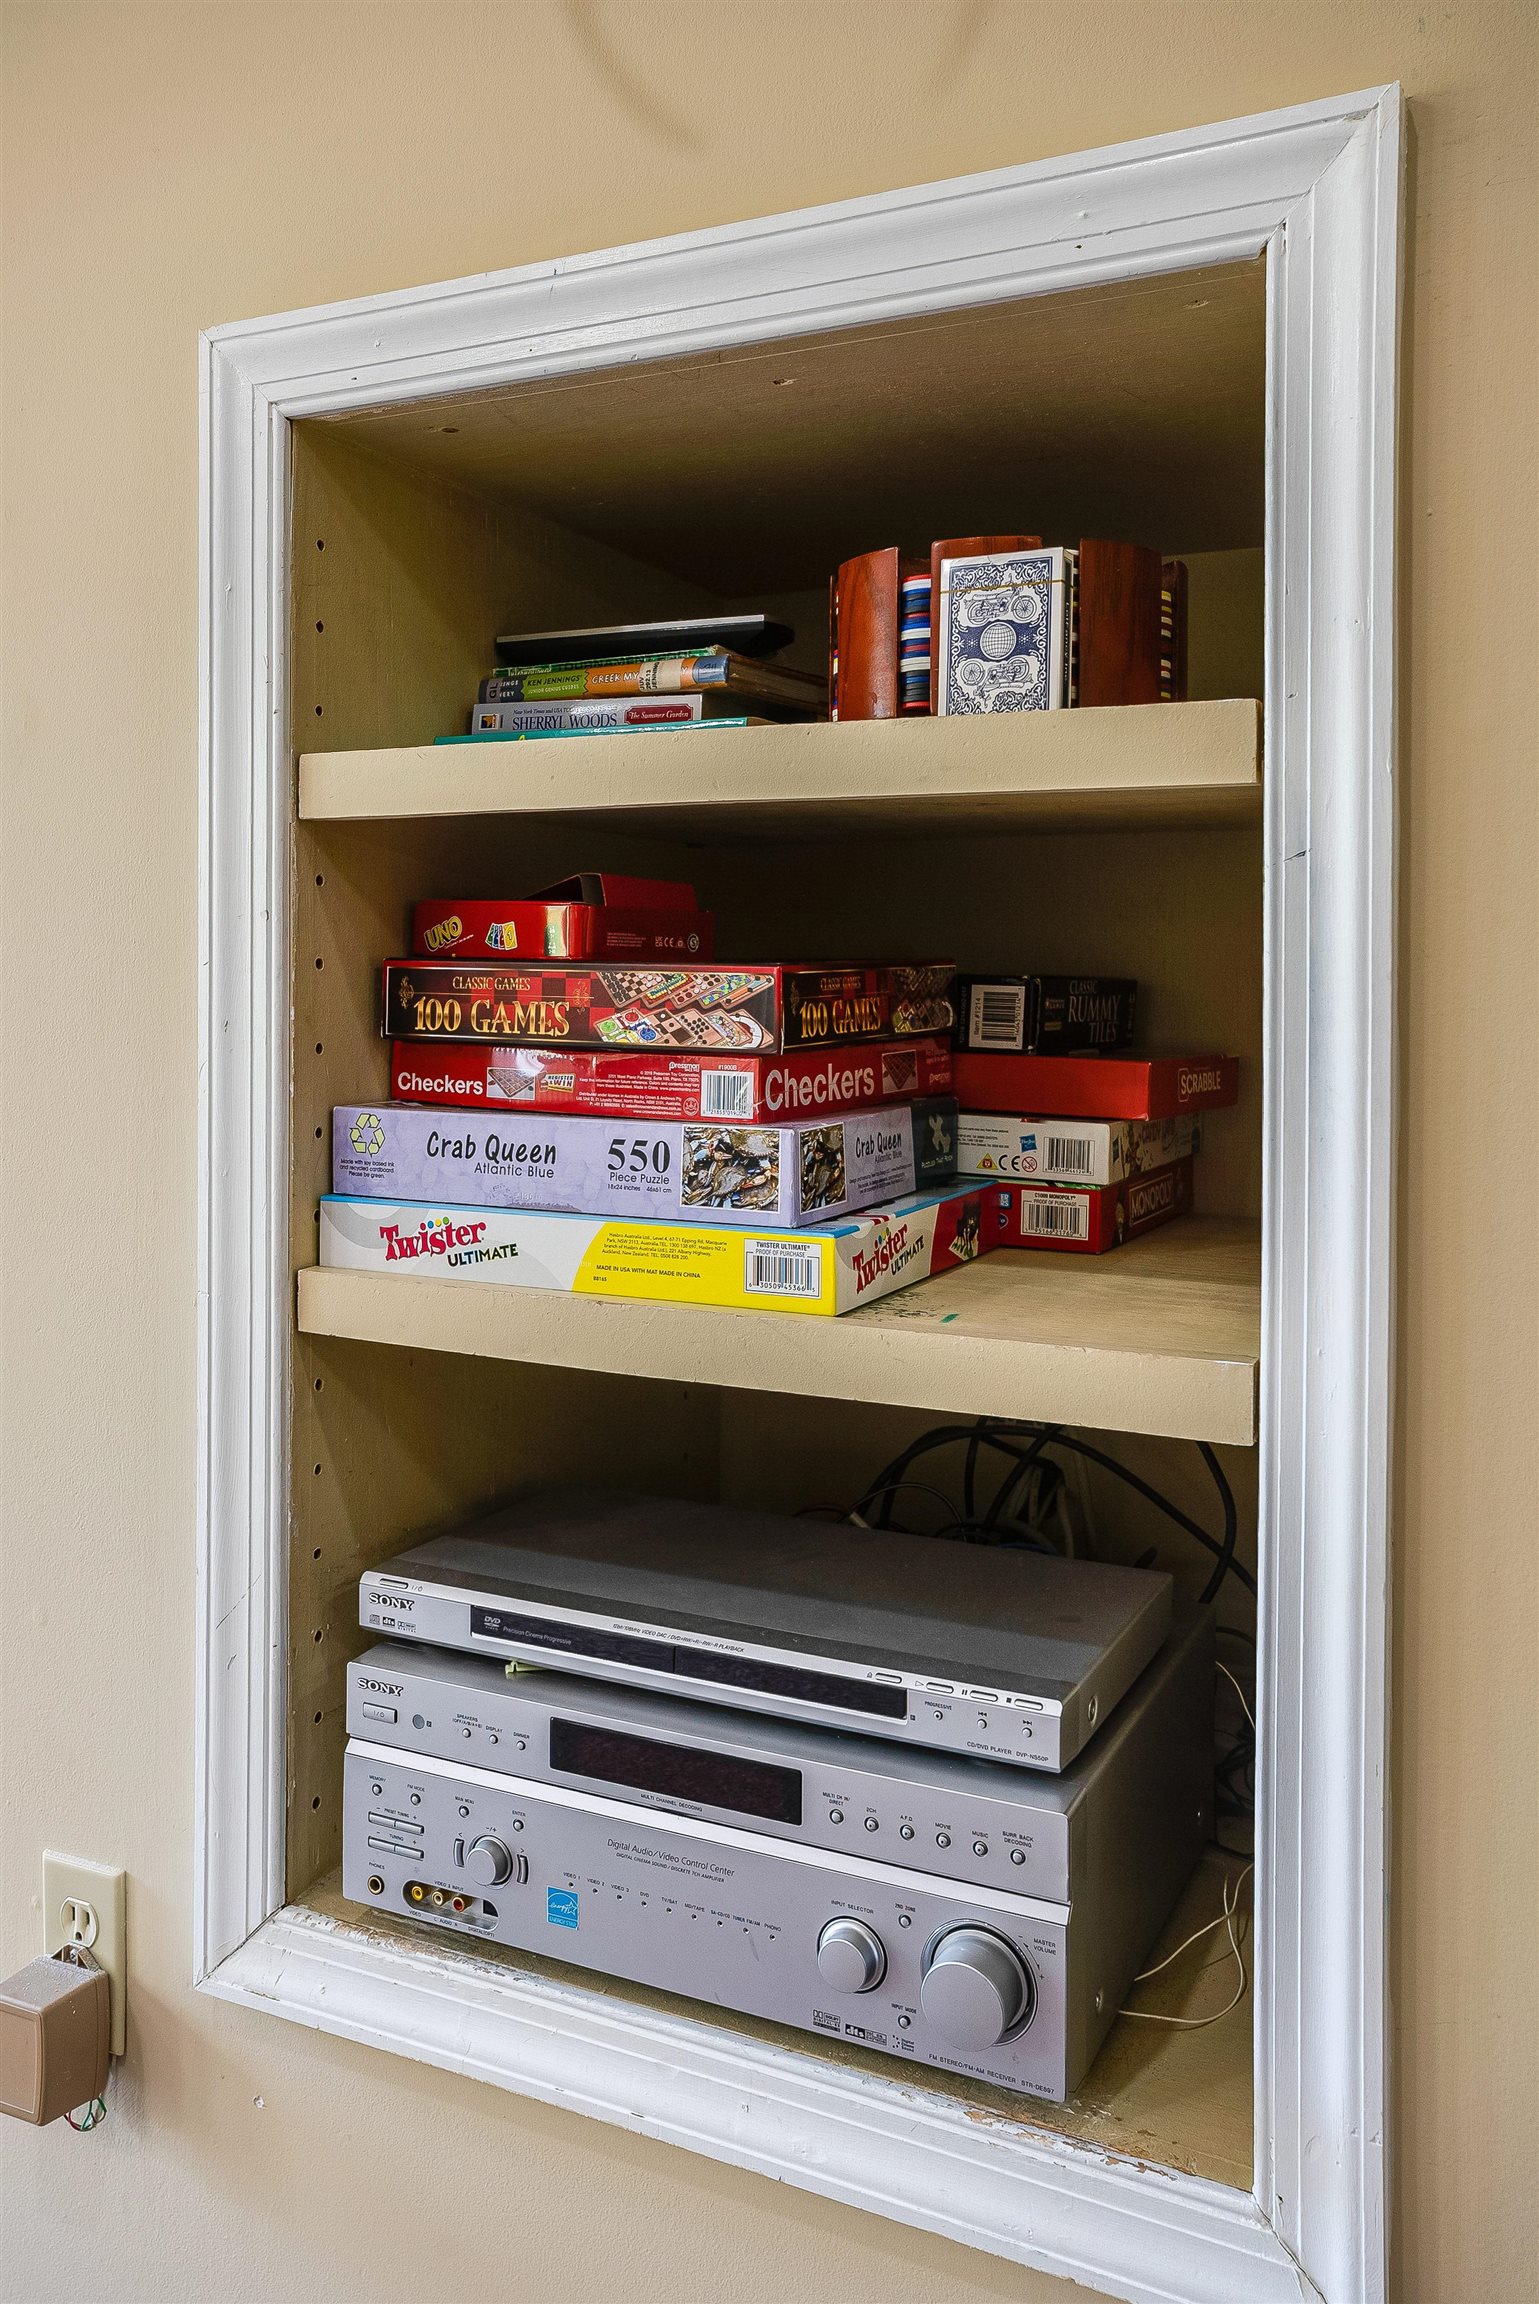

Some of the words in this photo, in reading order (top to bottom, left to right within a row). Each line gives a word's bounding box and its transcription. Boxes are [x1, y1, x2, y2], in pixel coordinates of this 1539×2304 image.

[527, 678, 542, 687] KEN
[591, 673, 620, 684] GREEK
[528, 687, 544, 695] JUNIOR
[641, 711, 666, 719] Summer
[666, 709, 689, 719] Garden
[512, 715, 567, 731] SHERRYL
[569, 713, 618, 729] WOODS
[423, 915, 463, 952] UNO
[452, 976, 493, 991] CLASSIC
[494, 977, 531, 992] GAMES
[820, 977, 843, 990] CLASSIC
[1069, 979, 1098, 995] CLASSIC
[1068, 994, 1122, 1023] RUMMY
[413, 995, 462, 1031] 100
[470, 999, 570, 1037] GAMES
[800, 1001, 828, 1039] 100
[832, 997, 882, 1035] GAMES
[1088, 1020, 1119, 1043] TILES
[397, 1071, 484, 1095] Checkers
[764, 1062, 875, 1111] Checkers
[1180, 1069, 1222, 1095] SCRABBLE
[426, 1130, 477, 1160] Crab
[484, 1133, 557, 1165] Queen
[855, 1135, 875, 1159] Crab
[877, 1131, 902, 1154] Queen
[606, 1138, 671, 1173] 550
[474, 1161, 523, 1178] Atlantic
[527, 1165, 555, 1179] Blue
[609, 1171, 638, 1183] Piece
[640, 1173, 671, 1185] Puzzle
[1131, 1178, 1174, 1217] MONOPOLY
[379, 1218, 487, 1261] Twister
[756, 1241, 780, 1249] TWISTER
[447, 1243, 519, 1268] ULTIMATE
[852, 1223, 908, 1294] Twister
[891, 1234, 925, 1276] ULTIMATE
[784, 1283, 806, 1292] 45366
[368, 1592, 415, 1611] SONY
[484, 1615, 501, 1624] DVD
[502, 1626, 525, 1637] Precision
[525, 1630, 543, 1641] Cinema
[543, 1634, 573, 1646] Progressive
[641, 1628, 656, 1636] VIDEO
[718, 1643, 745, 1653] PLAYBACK
[357, 1677, 404, 1697] SONY
[924, 1701, 952, 1711] PROGRESSIVE
[485, 1725, 503, 1733] DISPLAY
[513, 1731, 530, 1739] DIMMER
[966, 1741, 989, 1751] CD/DVD
[990, 1745, 1012, 1755] PLAYER
[369, 1774, 387, 1783] MEMORY
[414, 1785, 426, 1793] MODE
[822, 1791, 836, 1799] MULTI
[640, 1793, 655, 1801] MULTI
[656, 1796, 677, 1806] CHANNEL
[678, 1801, 703, 1812] DECODING
[828, 1799, 844, 1807] DIRECT
[511, 1810, 526, 1818] ENTER
[935, 1822, 951, 1831] MOVIE
[389, 1833, 404, 1842] TUNING
[971, 1830, 989, 1839] MUSIC
[1018, 1834, 1034, 1842] BACK
[1004, 1838, 1032, 1849] DECODING
[607, 1838, 631, 1852] Digital
[632, 1843, 680, 1863] Audio/Video
[681, 1856, 709, 1871] Control
[709, 1863, 735, 1877] Center
[368, 1861, 385, 1870] PHONES
[616, 1852, 633, 1861] DIGITAL
[633, 1855, 651, 1864] CINEMA
[651, 1860, 667, 1869] SOUND
[670, 1865, 691, 1875] DISCRETE
[701, 1873, 725, 1883] AMPLIFIER
[563, 1871, 576, 1879] VIDEO
[587, 1878, 600, 1886] VIDEO
[611, 1884, 624, 1892] VIDEO
[661, 1896, 678, 1905] TV/SAT
[684, 1903, 705, 1912] MD/TAPE
[830, 1900, 846, 1908] INPUT
[847, 1903, 874, 1914] SELECTOR
[905, 1905, 916, 1913] ZONE
[711, 1909, 731, 1919] SA-CD/CD
[732, 1915, 746, 1923] TUNER
[440, 1918, 452, 1926] AUDIO
[764, 1923, 782, 1932] PHONO
[1033, 1937, 1056, 1948] MASTER
[1033, 1945, 1057, 1955] VOLUME
[891, 2003, 904, 2011] INPUT
[846, 2026, 865, 2038] dts
[928, 2053, 938, 2061] FM
[987, 2069, 1016, 2084] RECEIVER
